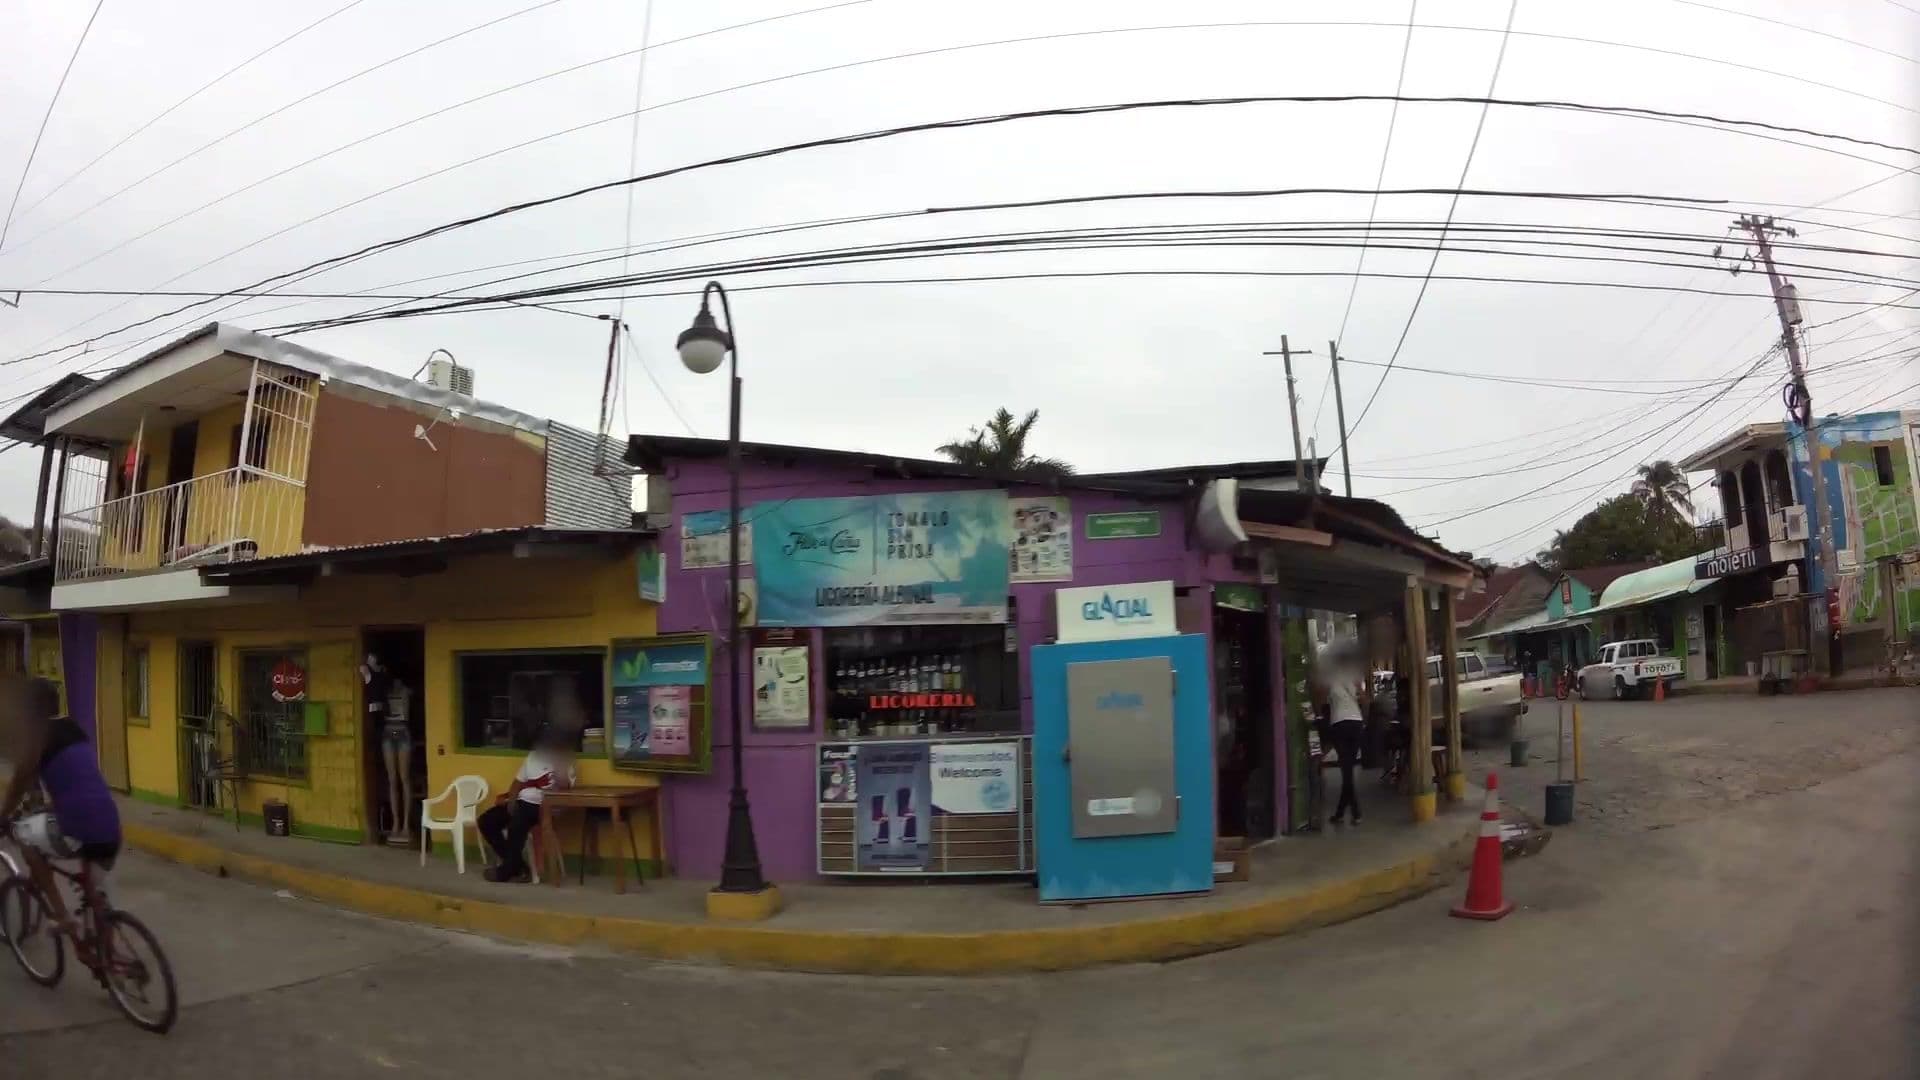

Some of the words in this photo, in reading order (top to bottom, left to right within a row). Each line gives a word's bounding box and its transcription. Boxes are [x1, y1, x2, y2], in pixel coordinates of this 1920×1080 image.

[1081, 592, 1153, 621] GLACIAL
[869, 693, 976, 709] LICORERIA
[939, 767, 1003, 779] Welcome
